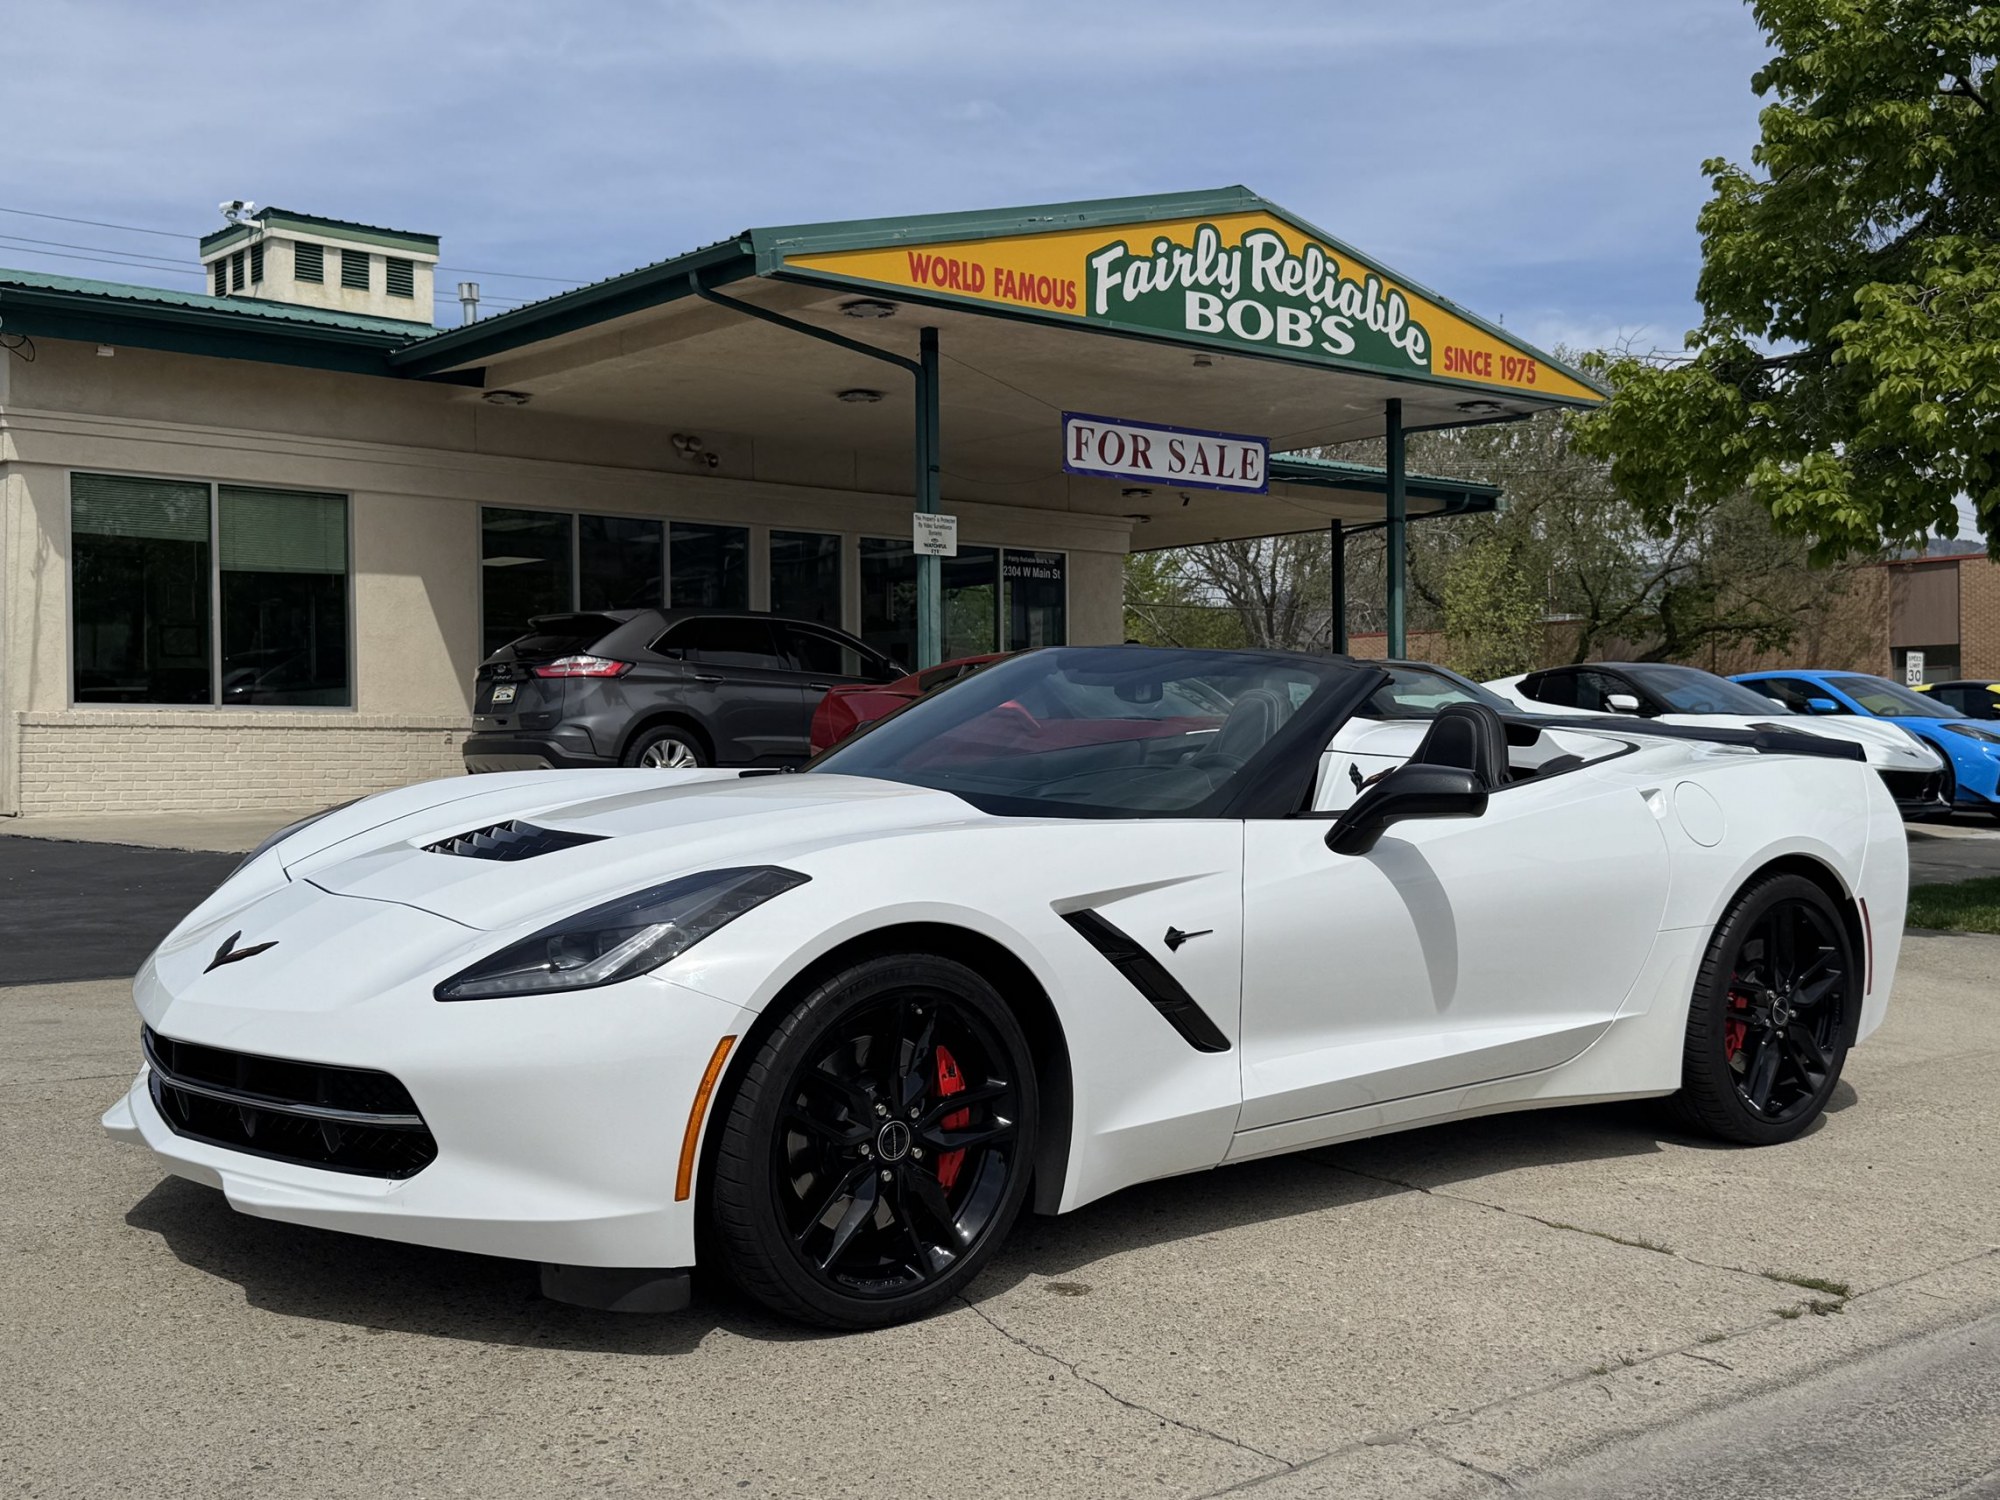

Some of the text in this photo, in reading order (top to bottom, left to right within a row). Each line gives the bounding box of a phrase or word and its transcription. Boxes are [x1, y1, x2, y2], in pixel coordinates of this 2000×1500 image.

[908, 251, 1077, 310] WORLD FAMOUS
[1091, 228, 1428, 365] Fairly Reliable
[1185, 290, 1355, 355] BOB'S
[1444, 345, 1536, 384] SINCE 1975
[1072, 425, 1260, 481] FOR SALE
[1003, 565, 1061, 580] 2304 W Main St
[1908, 669, 1921, 682] 30
